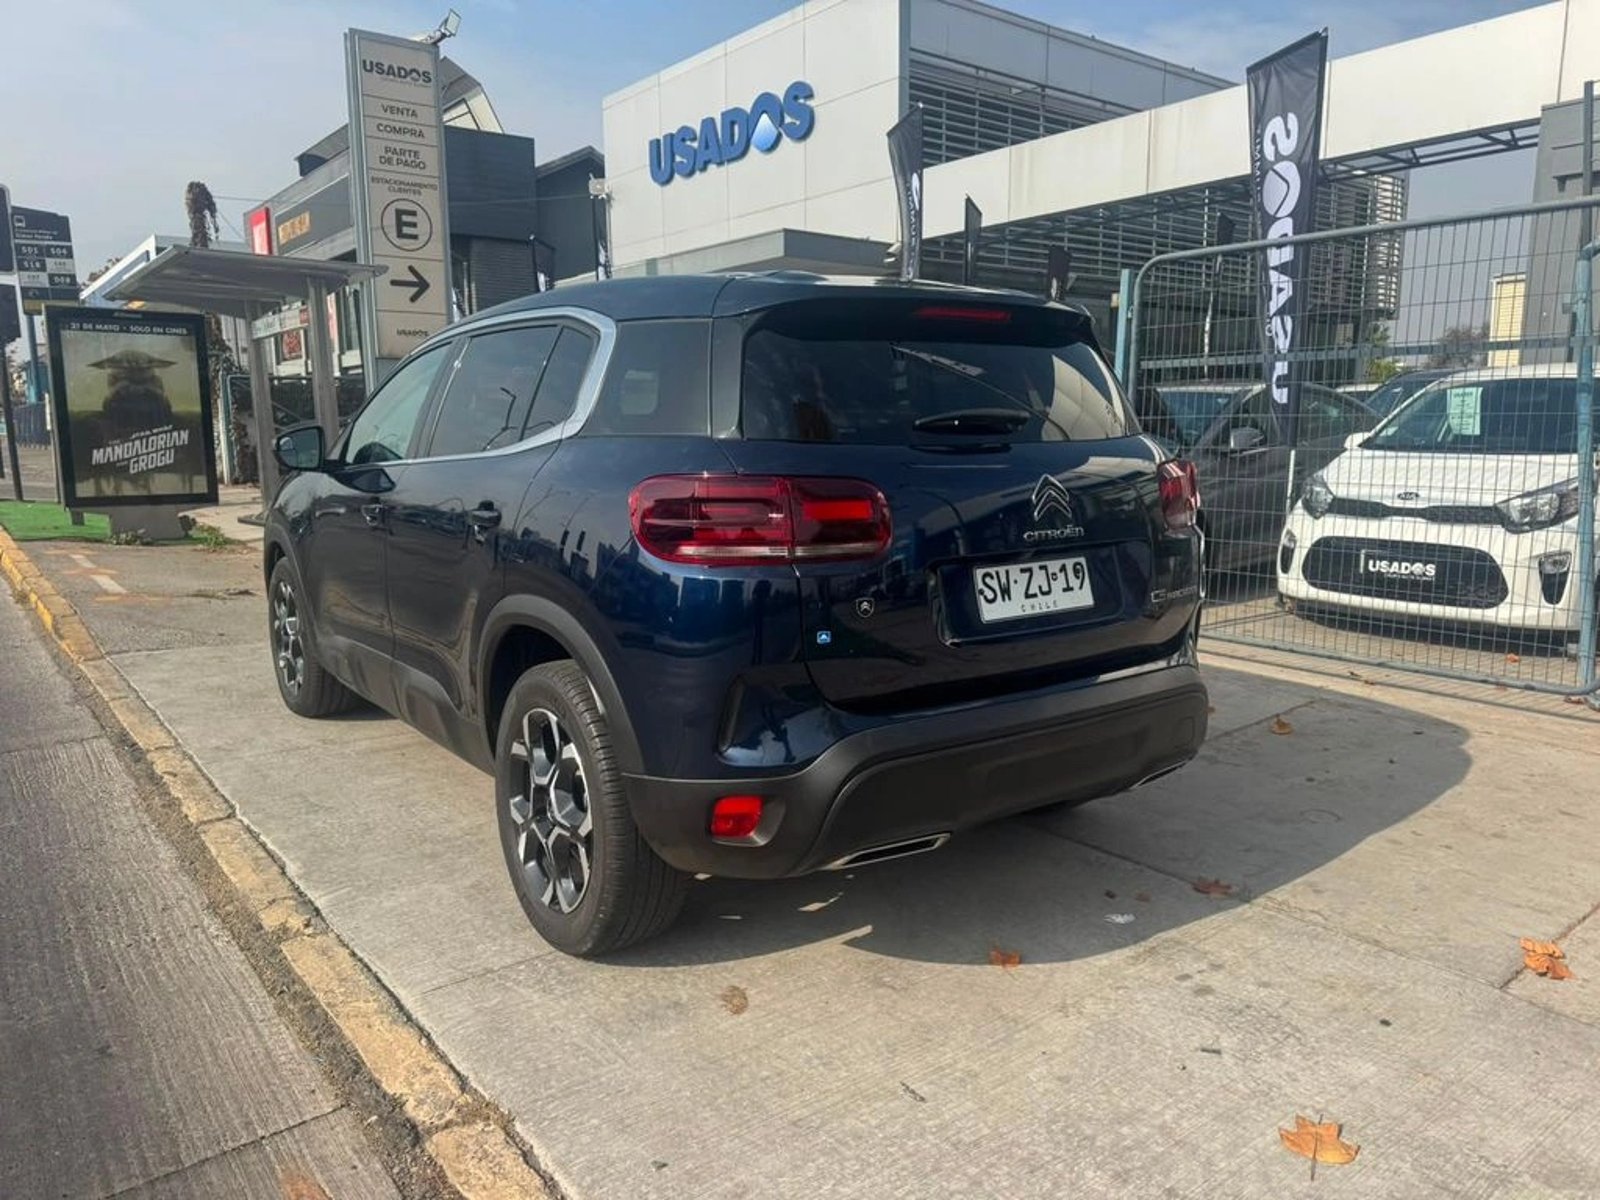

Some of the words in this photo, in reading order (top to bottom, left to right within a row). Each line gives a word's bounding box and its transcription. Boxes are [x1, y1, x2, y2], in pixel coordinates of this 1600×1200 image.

[362, 59, 432, 84] USADOS
[381, 103, 418, 118] VENTA
[376, 123, 425, 139] COMPRA
[648, 80, 816, 187] USADOS
[384, 146, 421, 160] PARTE
[379, 155, 395, 167] DE
[396, 157, 426, 170] PAGO
[387, 185, 422, 196] CLIENTES
[395, 208, 419, 240] E
[92, 428, 189, 466] MANDALORIAN
[129, 448, 174, 475] GROGU
[1368, 559, 1436, 576] USADOS
[1021, 600, 1058, 613] CHILE
